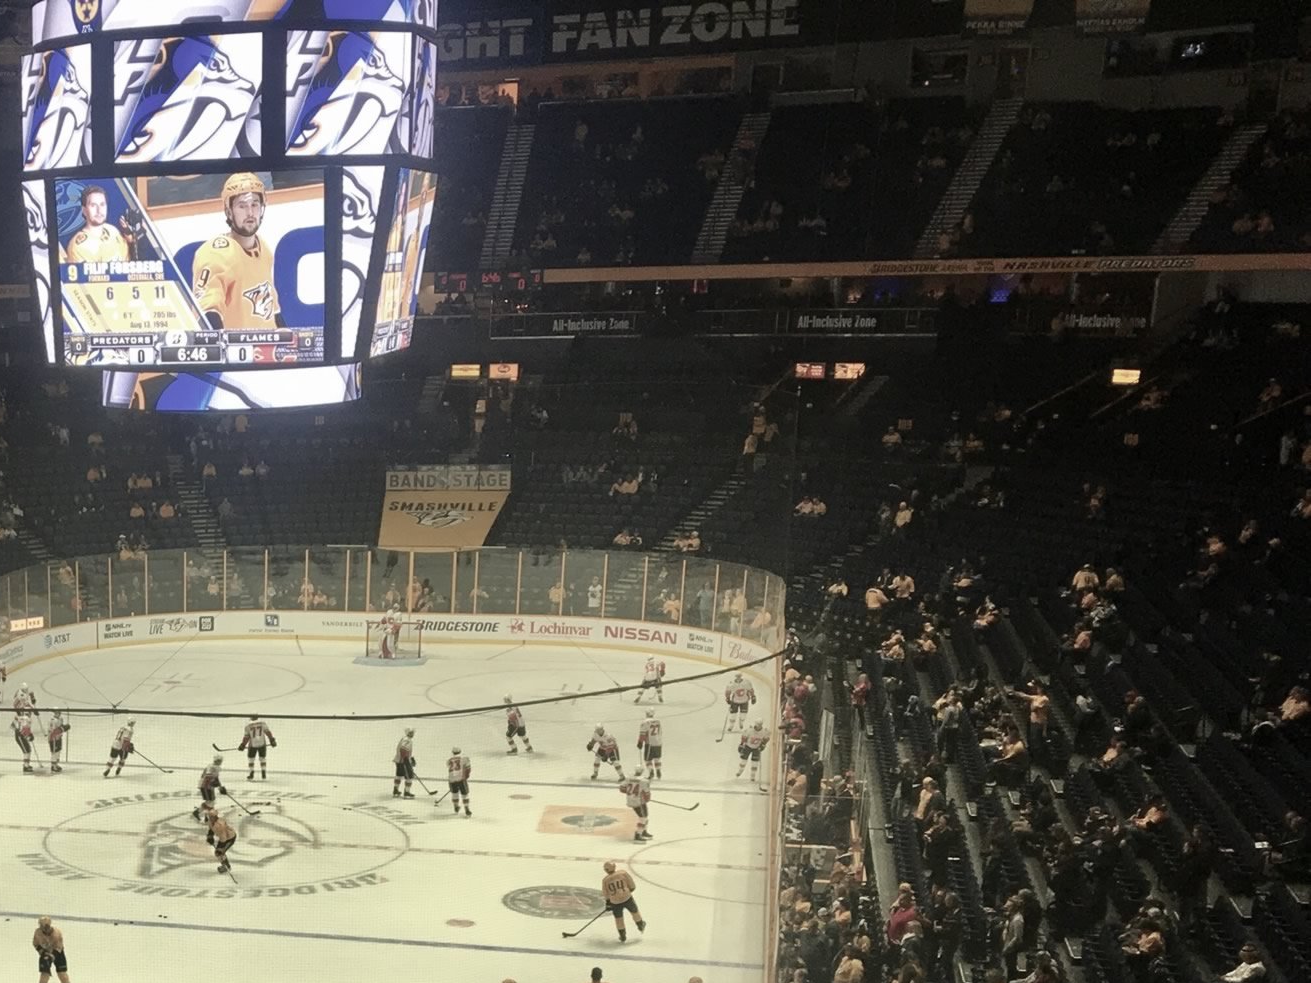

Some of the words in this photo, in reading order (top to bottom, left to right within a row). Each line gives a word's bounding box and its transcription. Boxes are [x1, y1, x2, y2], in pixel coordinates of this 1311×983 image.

[552, 9, 652, 52] FAN
[659, 2, 801, 45] ZONE
[871, 262, 939, 273] BRIDGESTONE
[1003, 260, 1091, 270] NASHVILLE
[1097, 258, 1195, 270] PREDATORS
[68, 264, 78, 281] 9
[83, 261, 109, 275] FILIP
[106, 286, 114, 300] 6
[132, 286, 140, 299] 5
[154, 286, 166, 299] 11
[553, 319, 606, 332] All-Inclusive
[608, 318, 630, 331] Zone
[797, 315, 853, 328] All-Inclusive
[854, 315, 877, 328] Zone
[92, 336, 151, 345] PREDATORS
[240, 333, 280, 342] FLAMES
[304, 337, 311, 347] 0
[75, 342, 82, 351] 0
[137, 349, 146, 363] 0
[177, 347, 208, 361] 6:46
[239, 347, 247, 361] 0
[389, 475, 438, 488] BAND
[451, 473, 508, 487] STAGE
[388, 501, 499, 512] SMASHVILLE
[149, 623, 164, 635] LIVE
[414, 619, 500, 632] BRIDGESTONE
[529, 621, 593, 637] Lochinvar
[122, 630, 133, 638] LIVE
[604, 625, 678, 645] NISSAN
[448, 758, 462, 773] 23
[626, 783, 640, 796] 24
[607, 878, 626, 897] 94
